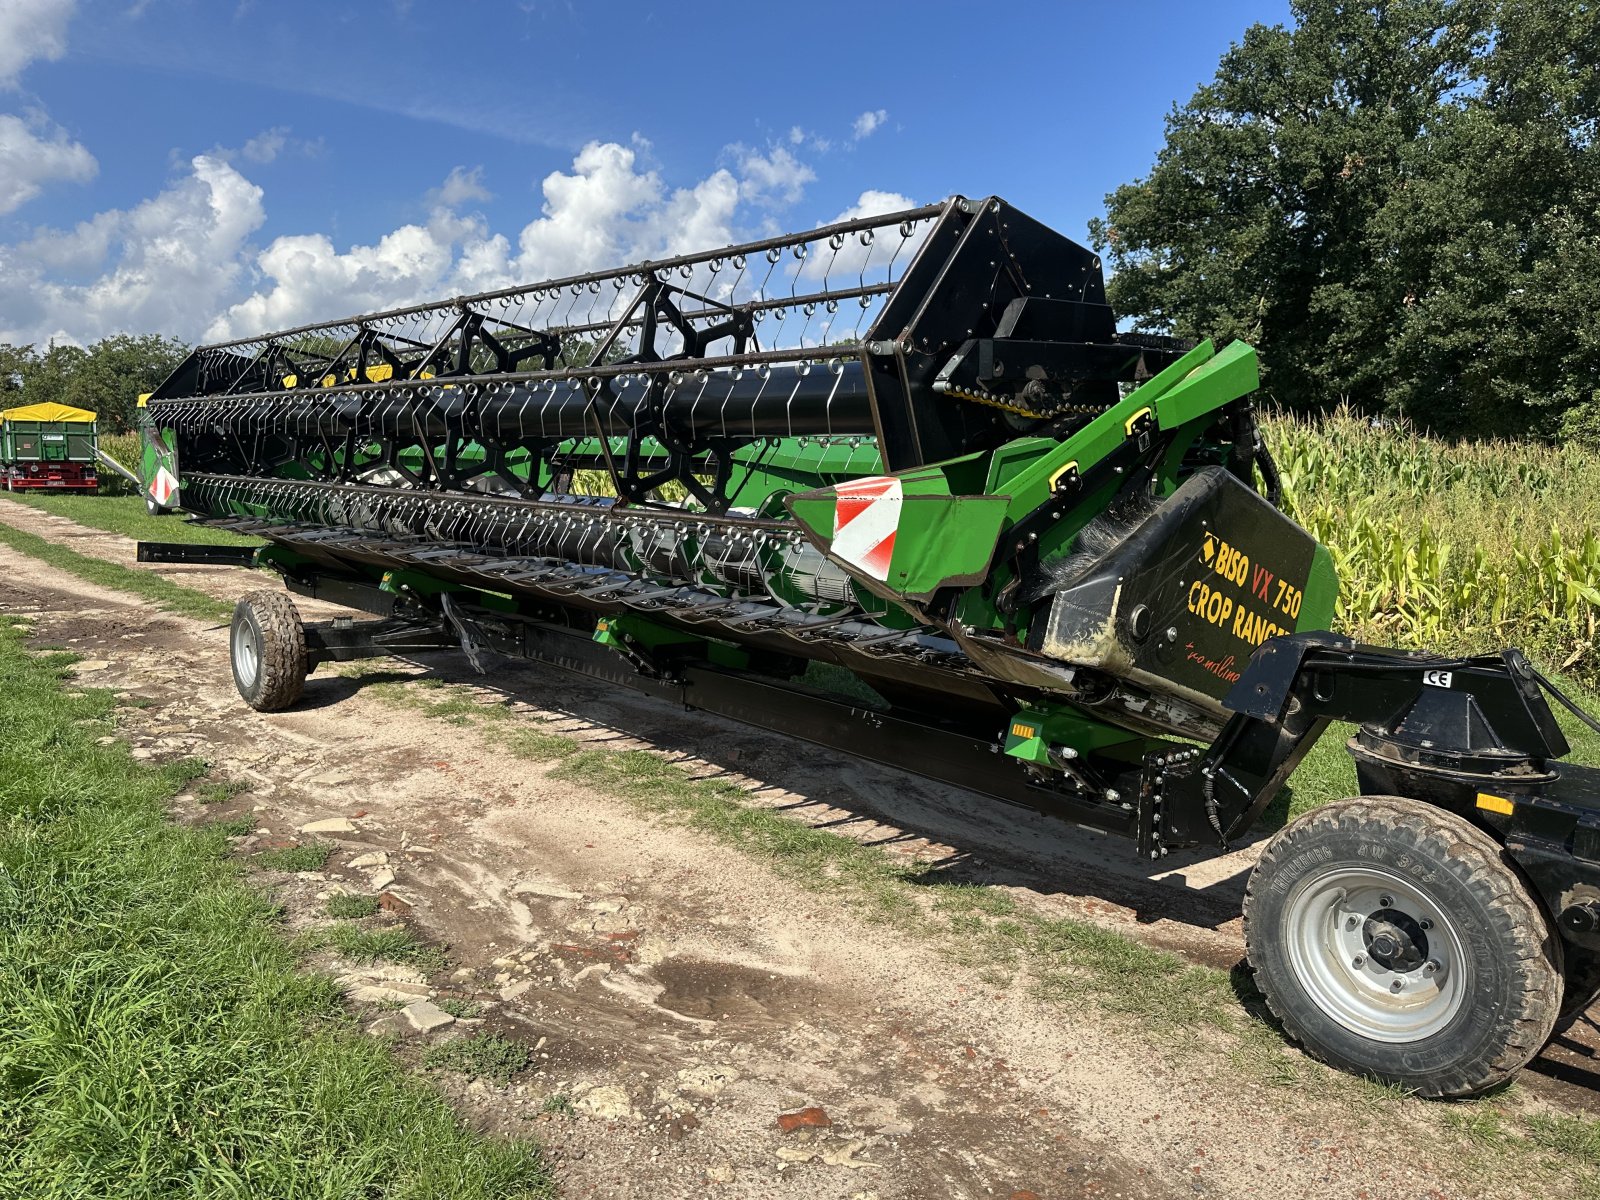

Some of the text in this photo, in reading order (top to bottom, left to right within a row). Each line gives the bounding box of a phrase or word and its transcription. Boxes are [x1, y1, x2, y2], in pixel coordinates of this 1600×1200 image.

[1188, 580, 1233, 627] CROP
[1215, 541, 1302, 619] BISO VX 750
[1428, 670, 1448, 686] CE
[1271, 845, 1333, 895] TRELLEBORG
